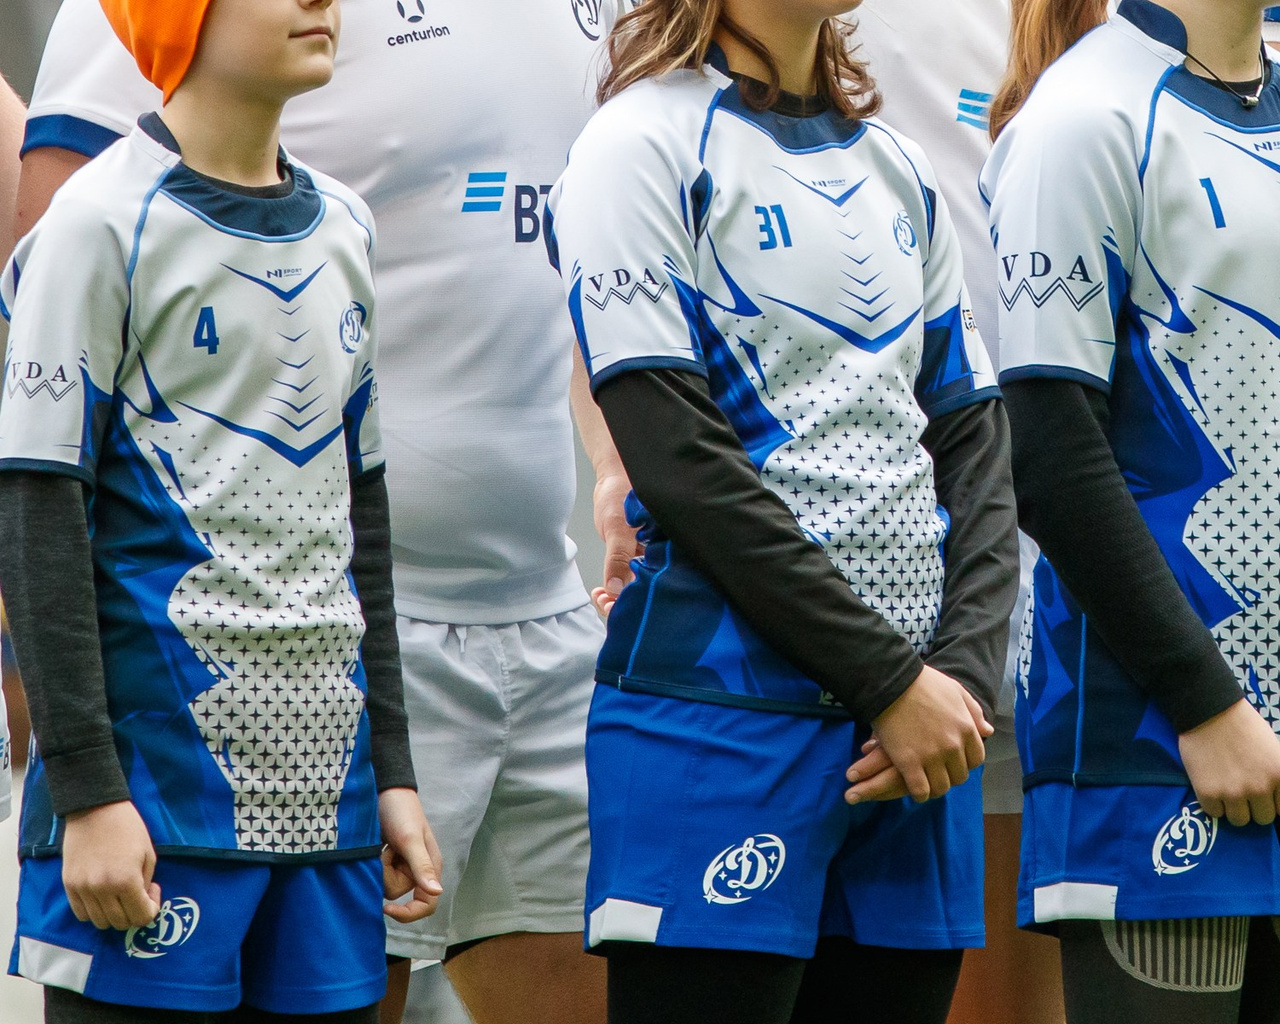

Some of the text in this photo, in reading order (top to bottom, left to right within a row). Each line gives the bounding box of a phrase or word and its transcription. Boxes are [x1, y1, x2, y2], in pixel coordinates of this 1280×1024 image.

[387, 25, 451, 47] centurion
[1200, 177, 1227, 229] 1
[754, 204, 793, 251] 31
[193, 306, 220, 355] 4
